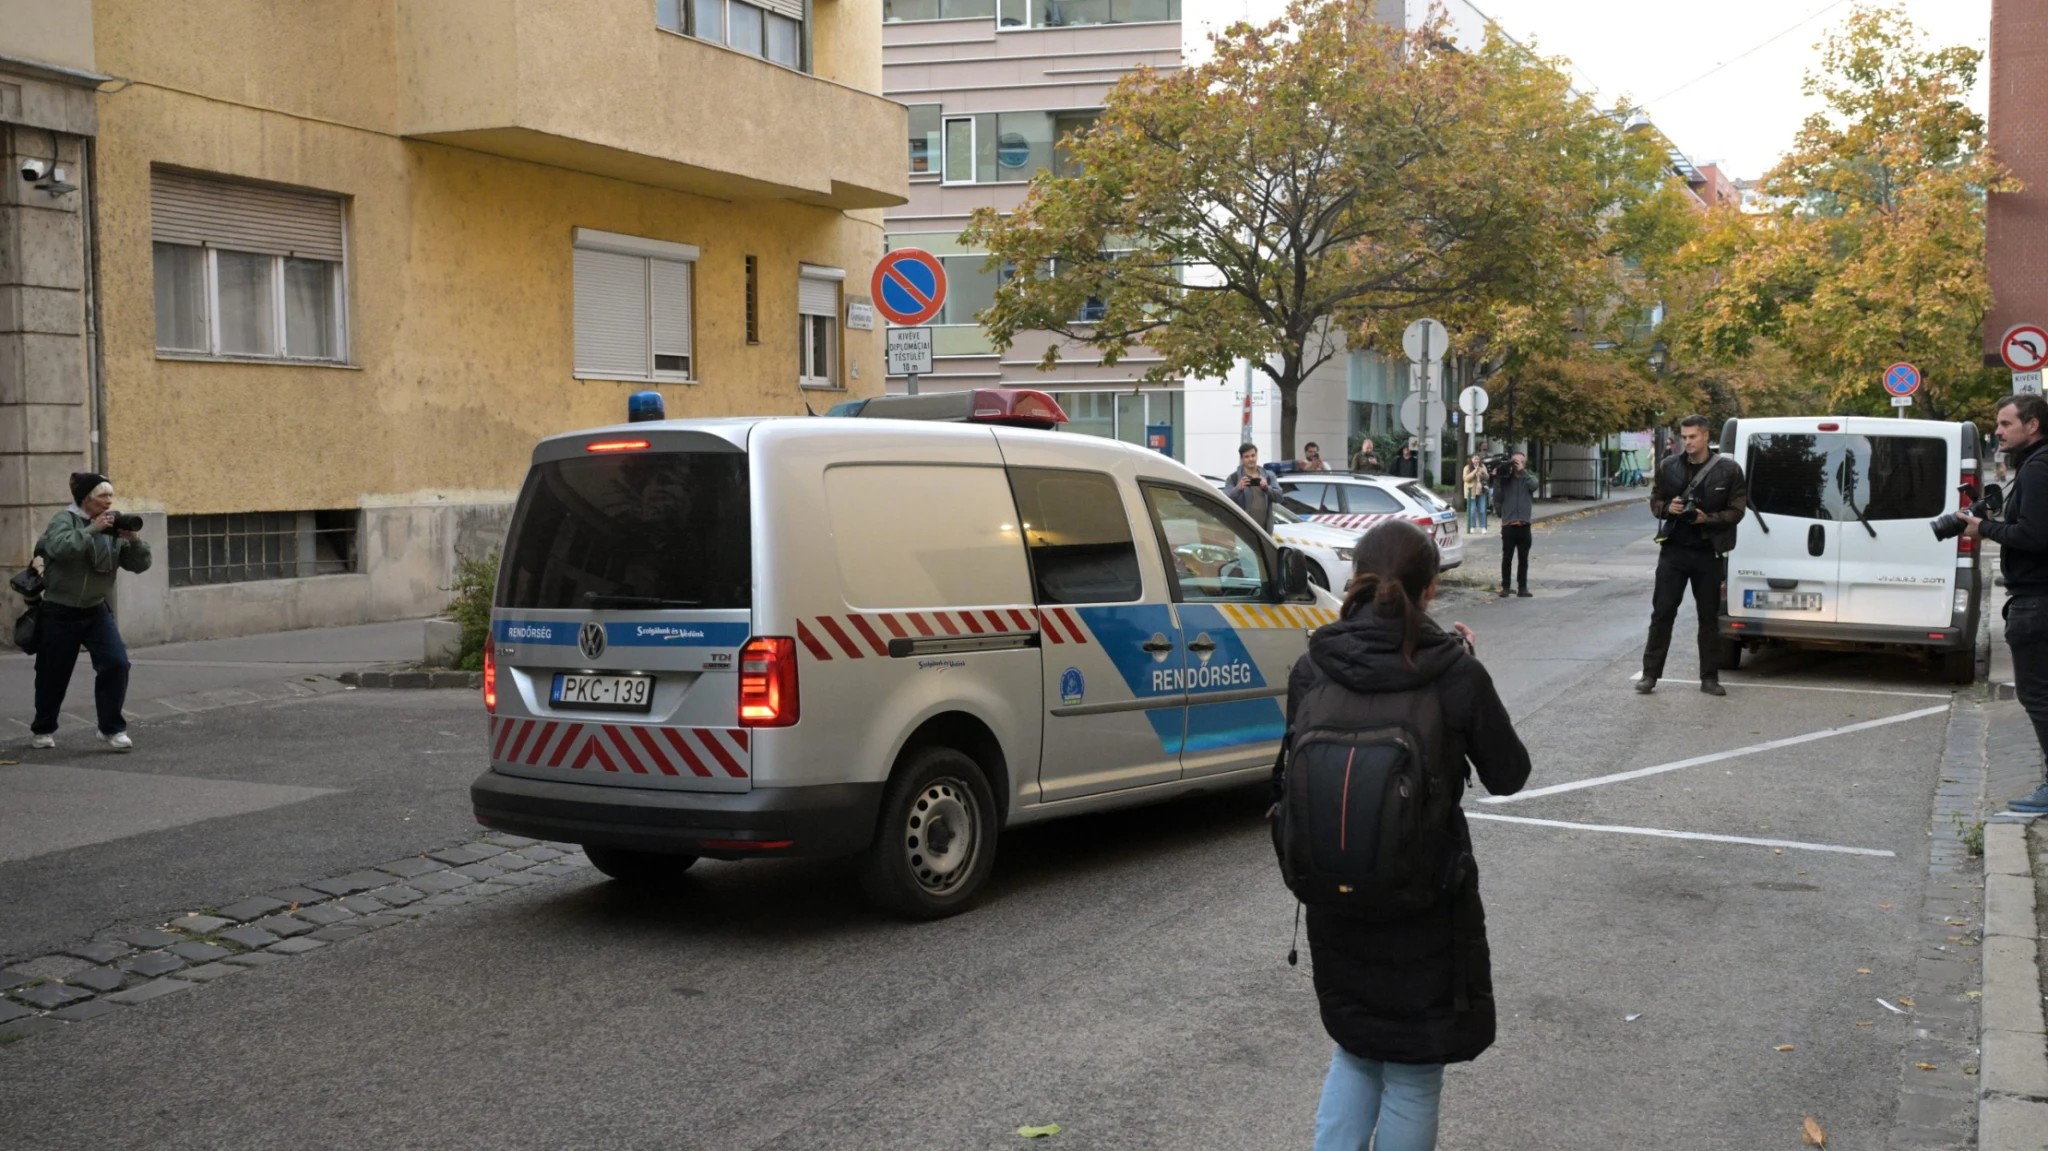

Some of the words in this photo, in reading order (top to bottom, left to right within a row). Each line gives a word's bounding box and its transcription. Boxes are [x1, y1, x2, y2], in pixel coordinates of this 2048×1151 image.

[508, 625, 552, 639] RENDŐRSÉG
[1152, 658, 1251, 691] RENDŐRSÉG
[564, 678, 645, 703] PKC-139
